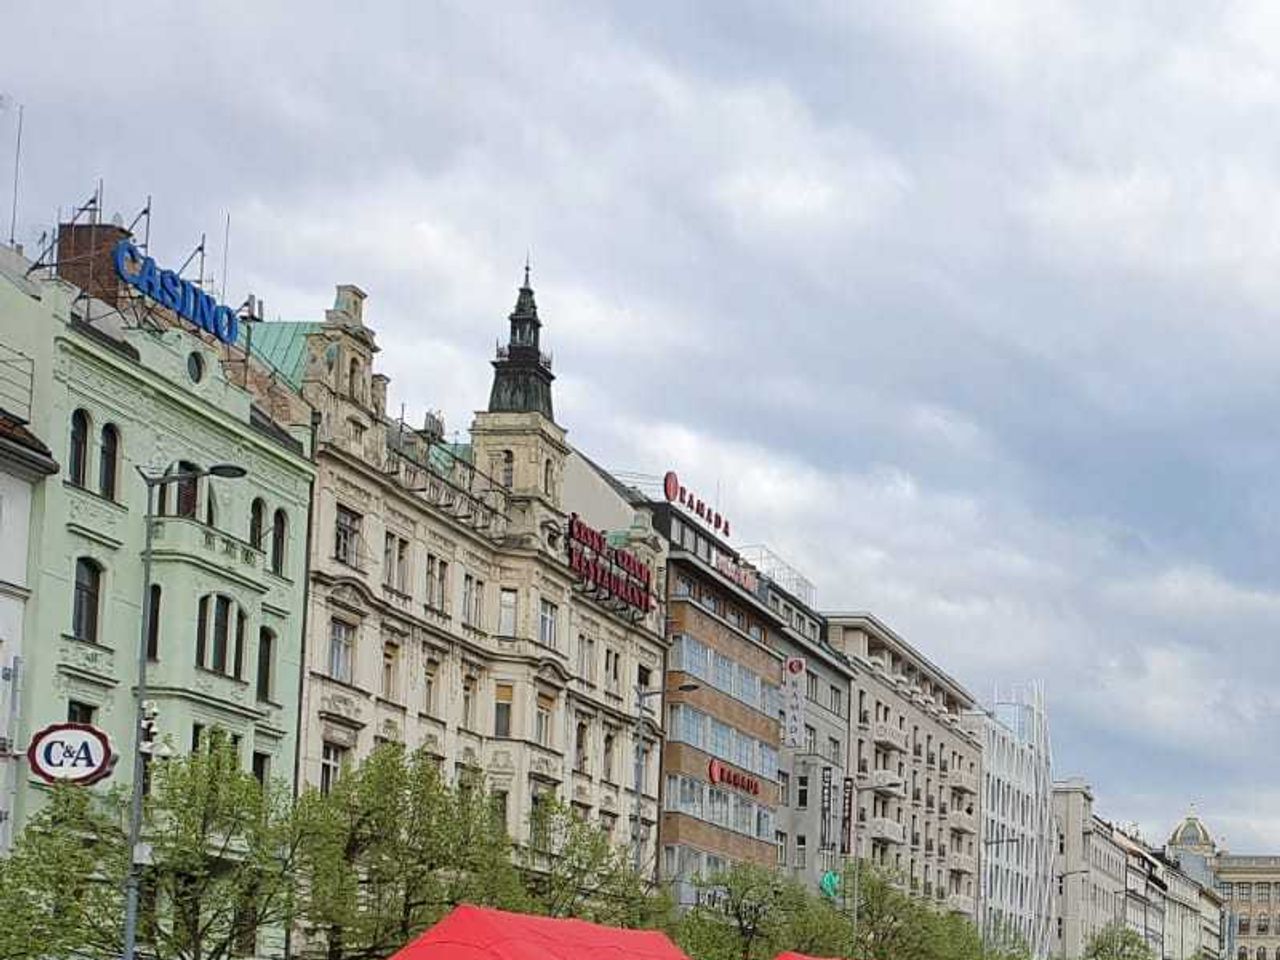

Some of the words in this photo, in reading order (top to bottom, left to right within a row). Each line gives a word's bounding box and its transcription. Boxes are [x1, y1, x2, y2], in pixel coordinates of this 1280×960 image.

[112, 238, 238, 344] CASINO
[680, 486, 730, 537] RAMADA
[43, 740, 96, 768] C&A
